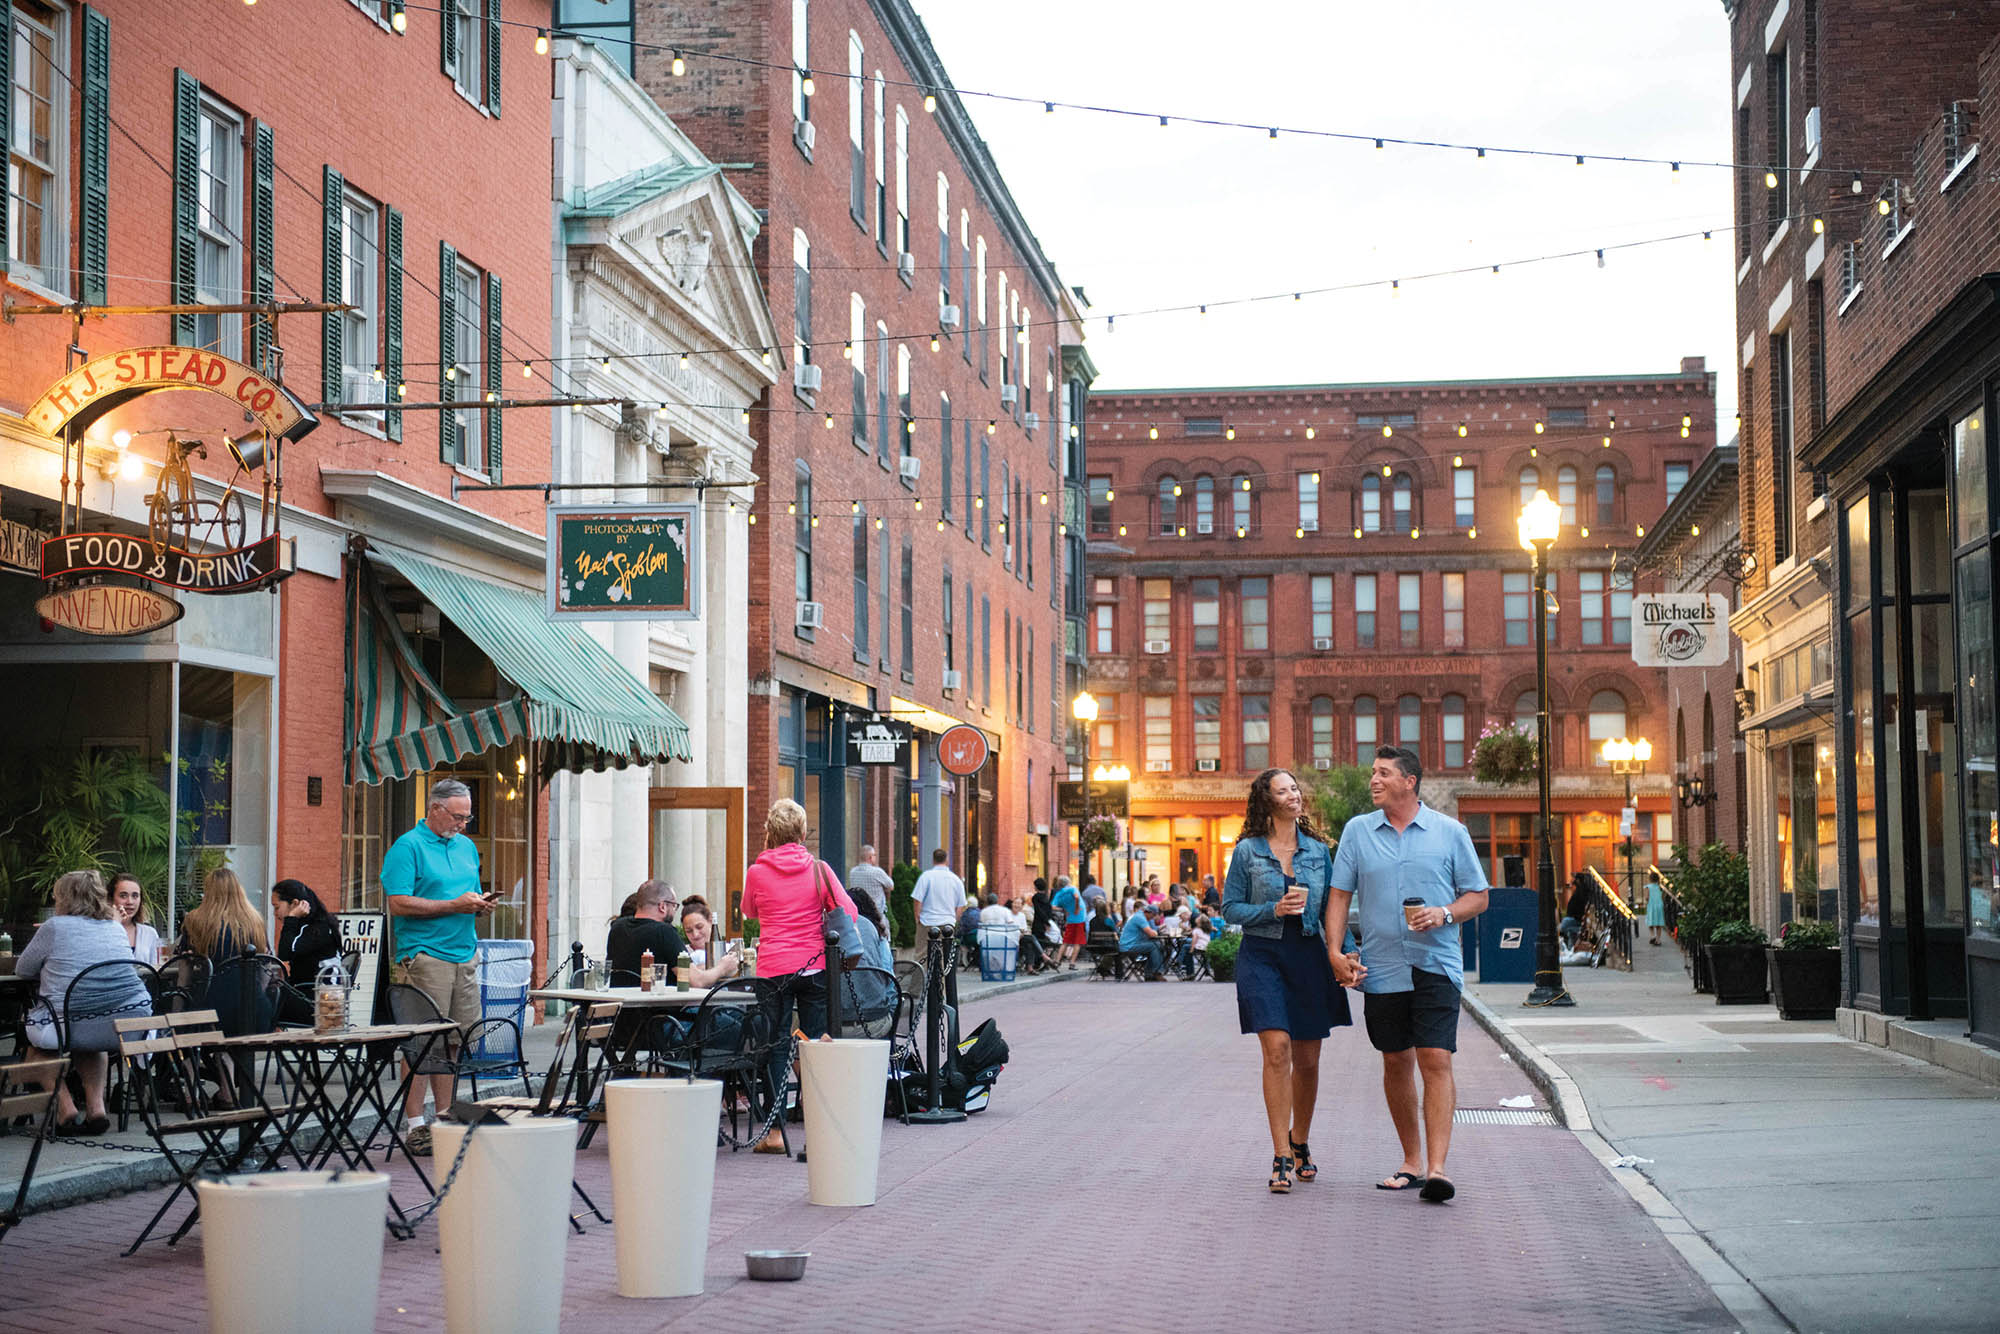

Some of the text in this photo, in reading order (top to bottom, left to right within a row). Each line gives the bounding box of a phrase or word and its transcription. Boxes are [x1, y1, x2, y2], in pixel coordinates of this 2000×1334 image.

[115, 351, 226, 387] STEAD
[584, 524, 661, 535] PHOTOGRAPHY
[616, 535, 629, 544] BY
[65, 537, 143, 569] FOOD
[146, 553, 166, 579] &
[176, 550, 262, 587] DRINK
[52, 588, 163, 631] INVENTORS
[864, 744, 895, 761] TABLE
[358, 920, 375, 936] OF
[343, 938, 378, 954] OUTH
